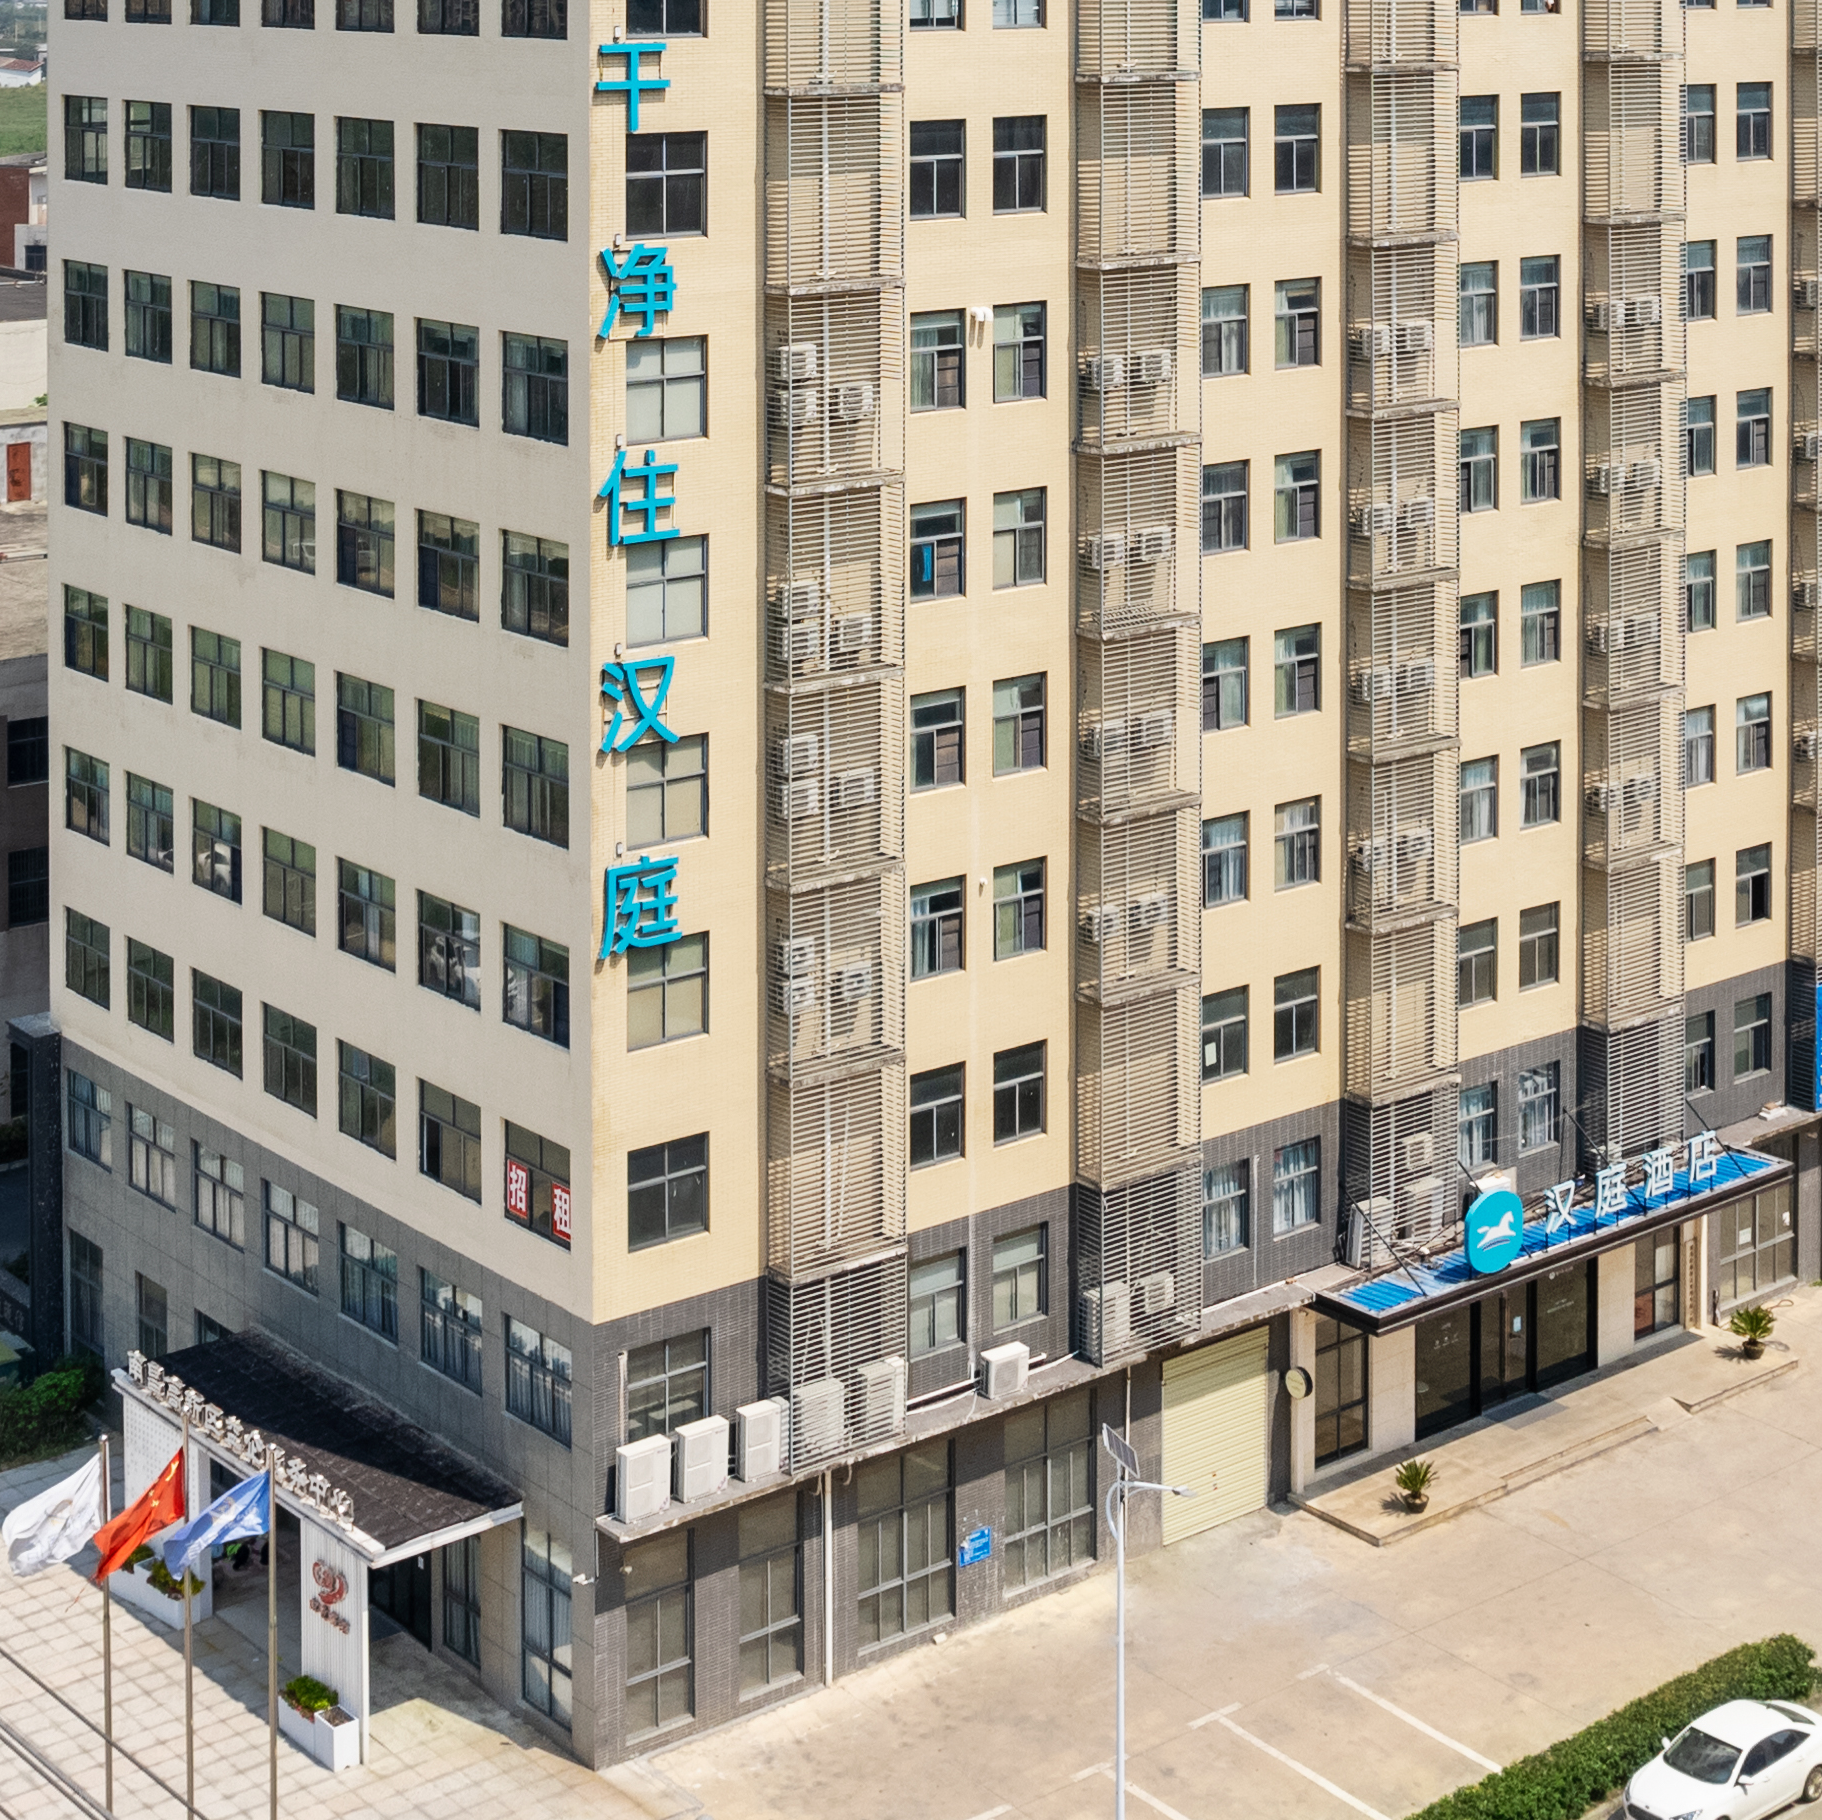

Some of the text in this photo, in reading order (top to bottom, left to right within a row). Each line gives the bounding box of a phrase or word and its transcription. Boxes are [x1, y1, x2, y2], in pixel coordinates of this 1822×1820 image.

[509, 1164, 572, 1234] 招租
[1543, 1129, 1718, 1235] 汉庭酒店
